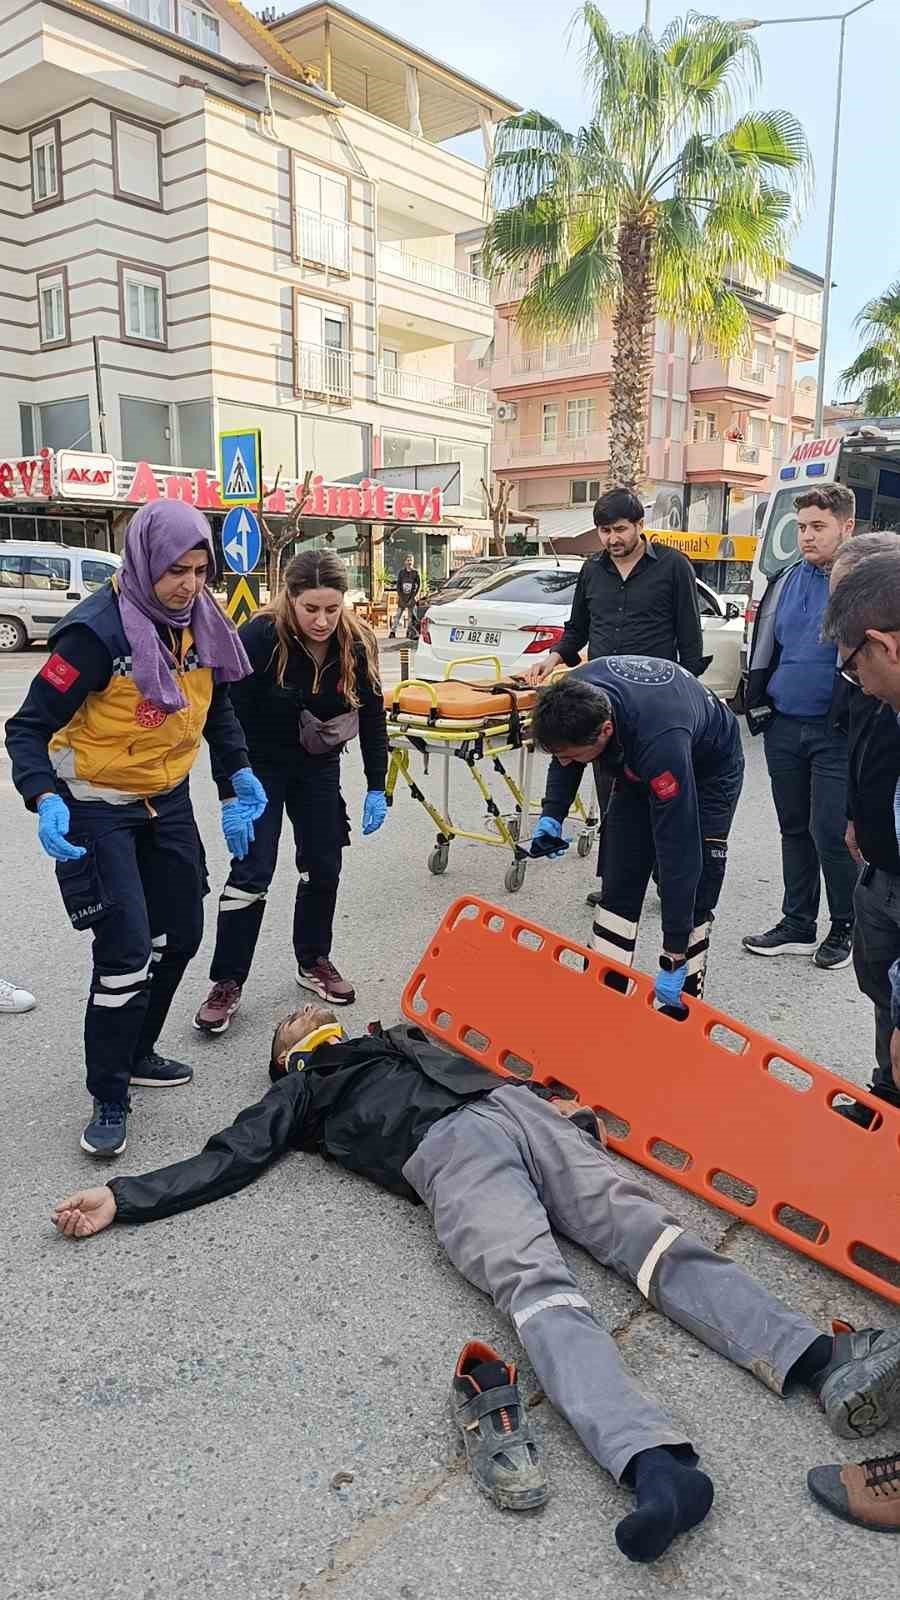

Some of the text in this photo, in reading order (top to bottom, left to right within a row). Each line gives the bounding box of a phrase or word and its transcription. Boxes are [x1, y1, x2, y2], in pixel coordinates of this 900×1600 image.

[789, 439, 840, 463] AMBU
[0, 448, 54, 498] evi
[67, 467, 112, 484] AKAT
[394, 486, 441, 523] evi
[456, 630, 464, 641] 07
